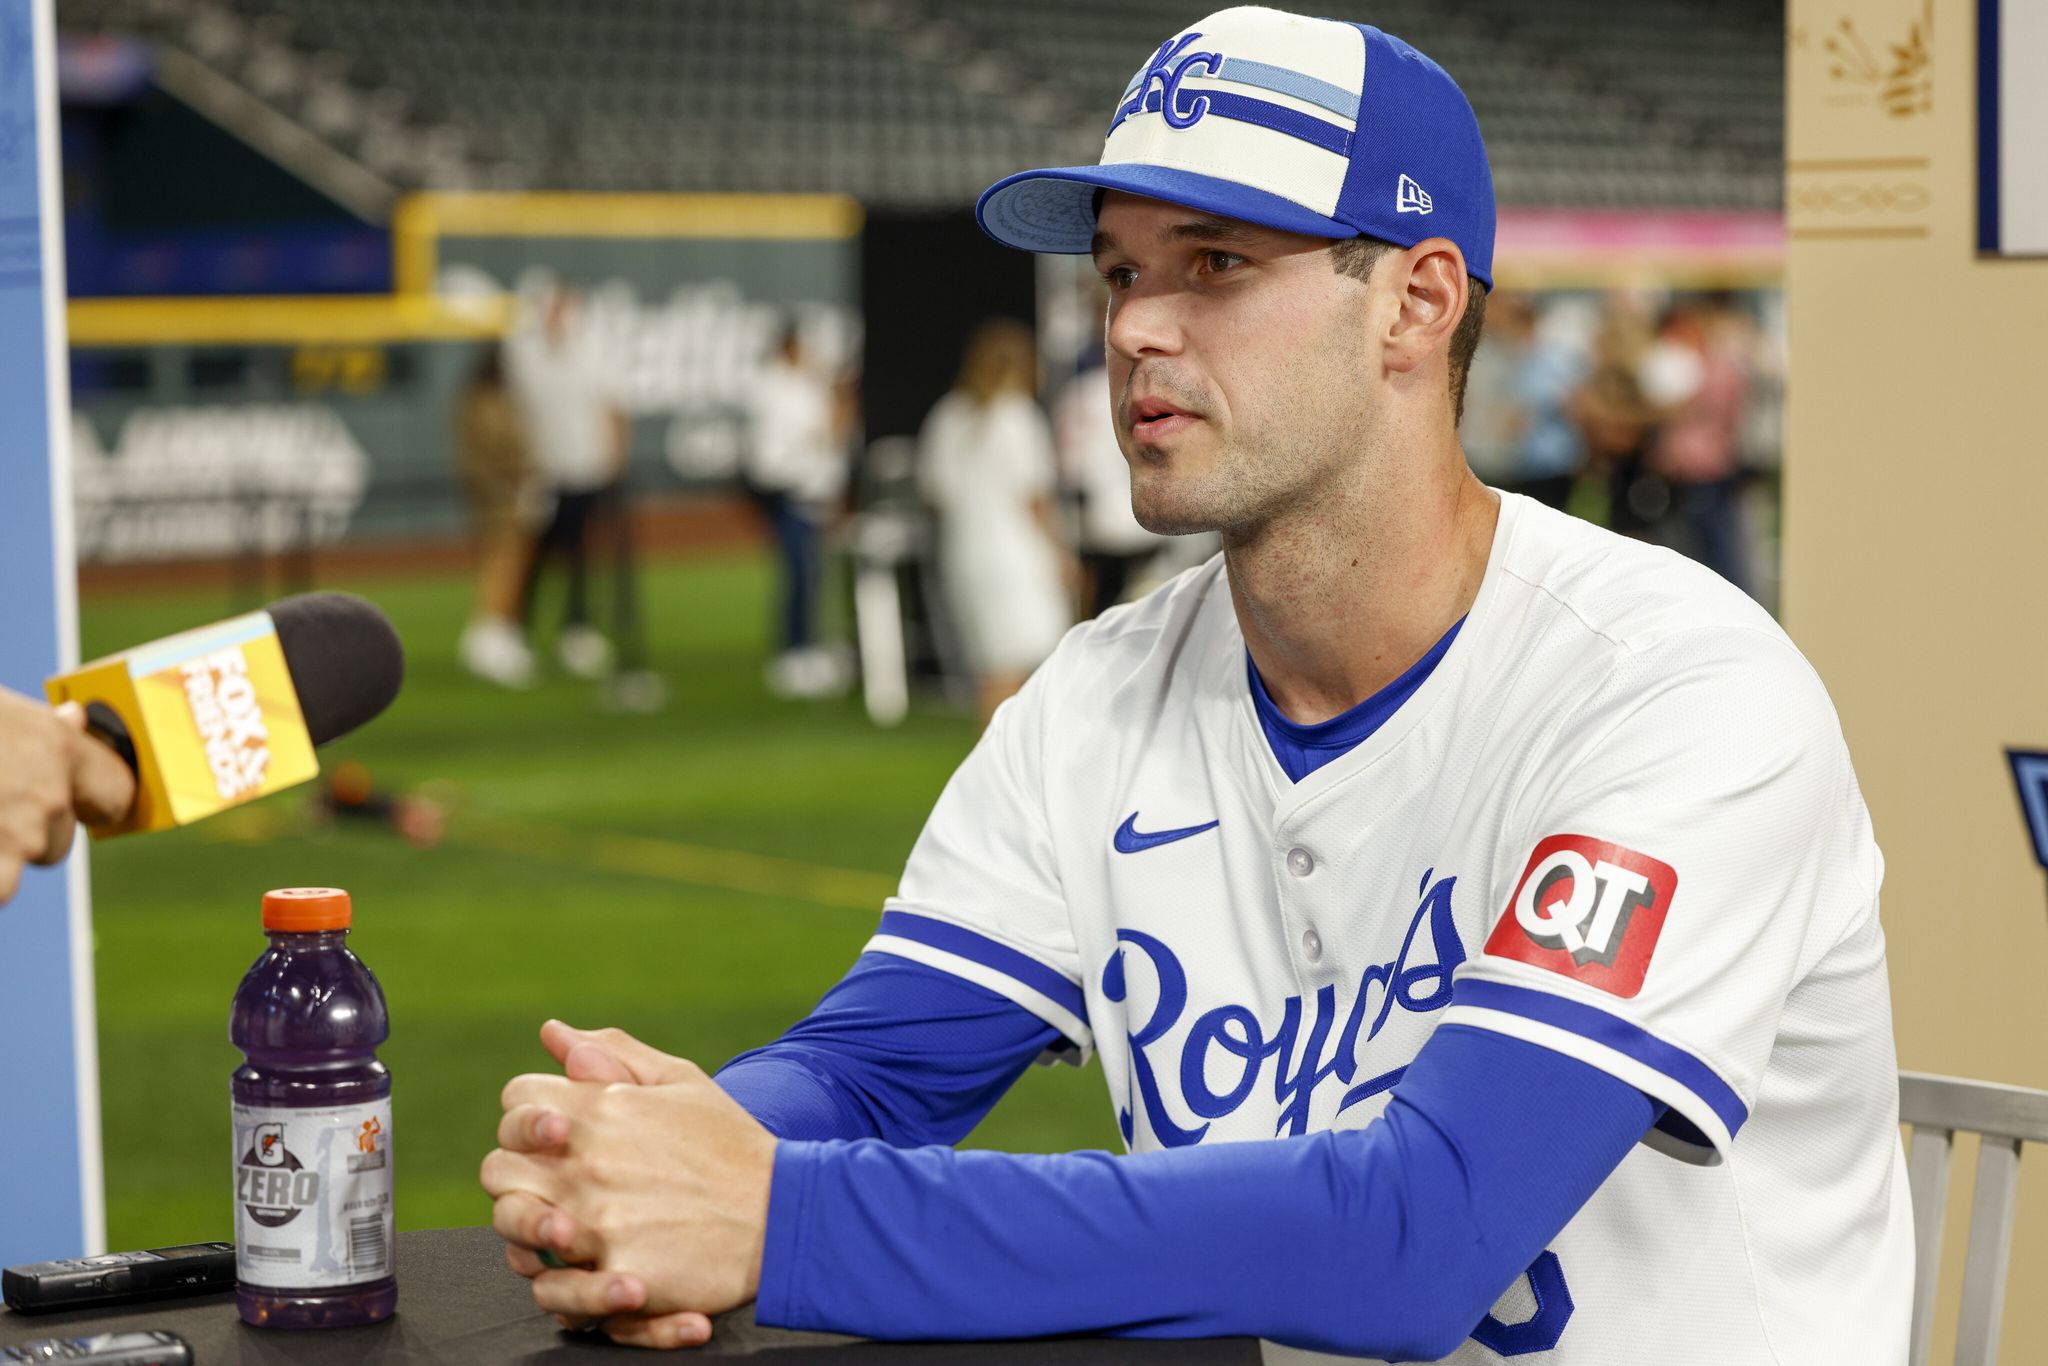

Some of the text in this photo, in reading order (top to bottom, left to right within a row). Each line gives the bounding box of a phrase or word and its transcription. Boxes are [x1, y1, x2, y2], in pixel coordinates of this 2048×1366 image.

[1128, 32, 1222, 130] KC
[1514, 849, 1653, 965] QT
[1102, 867, 1467, 1149] Roys
[237, 1166, 320, 1207] ZERO
[253, 1121, 286, 1167] G
